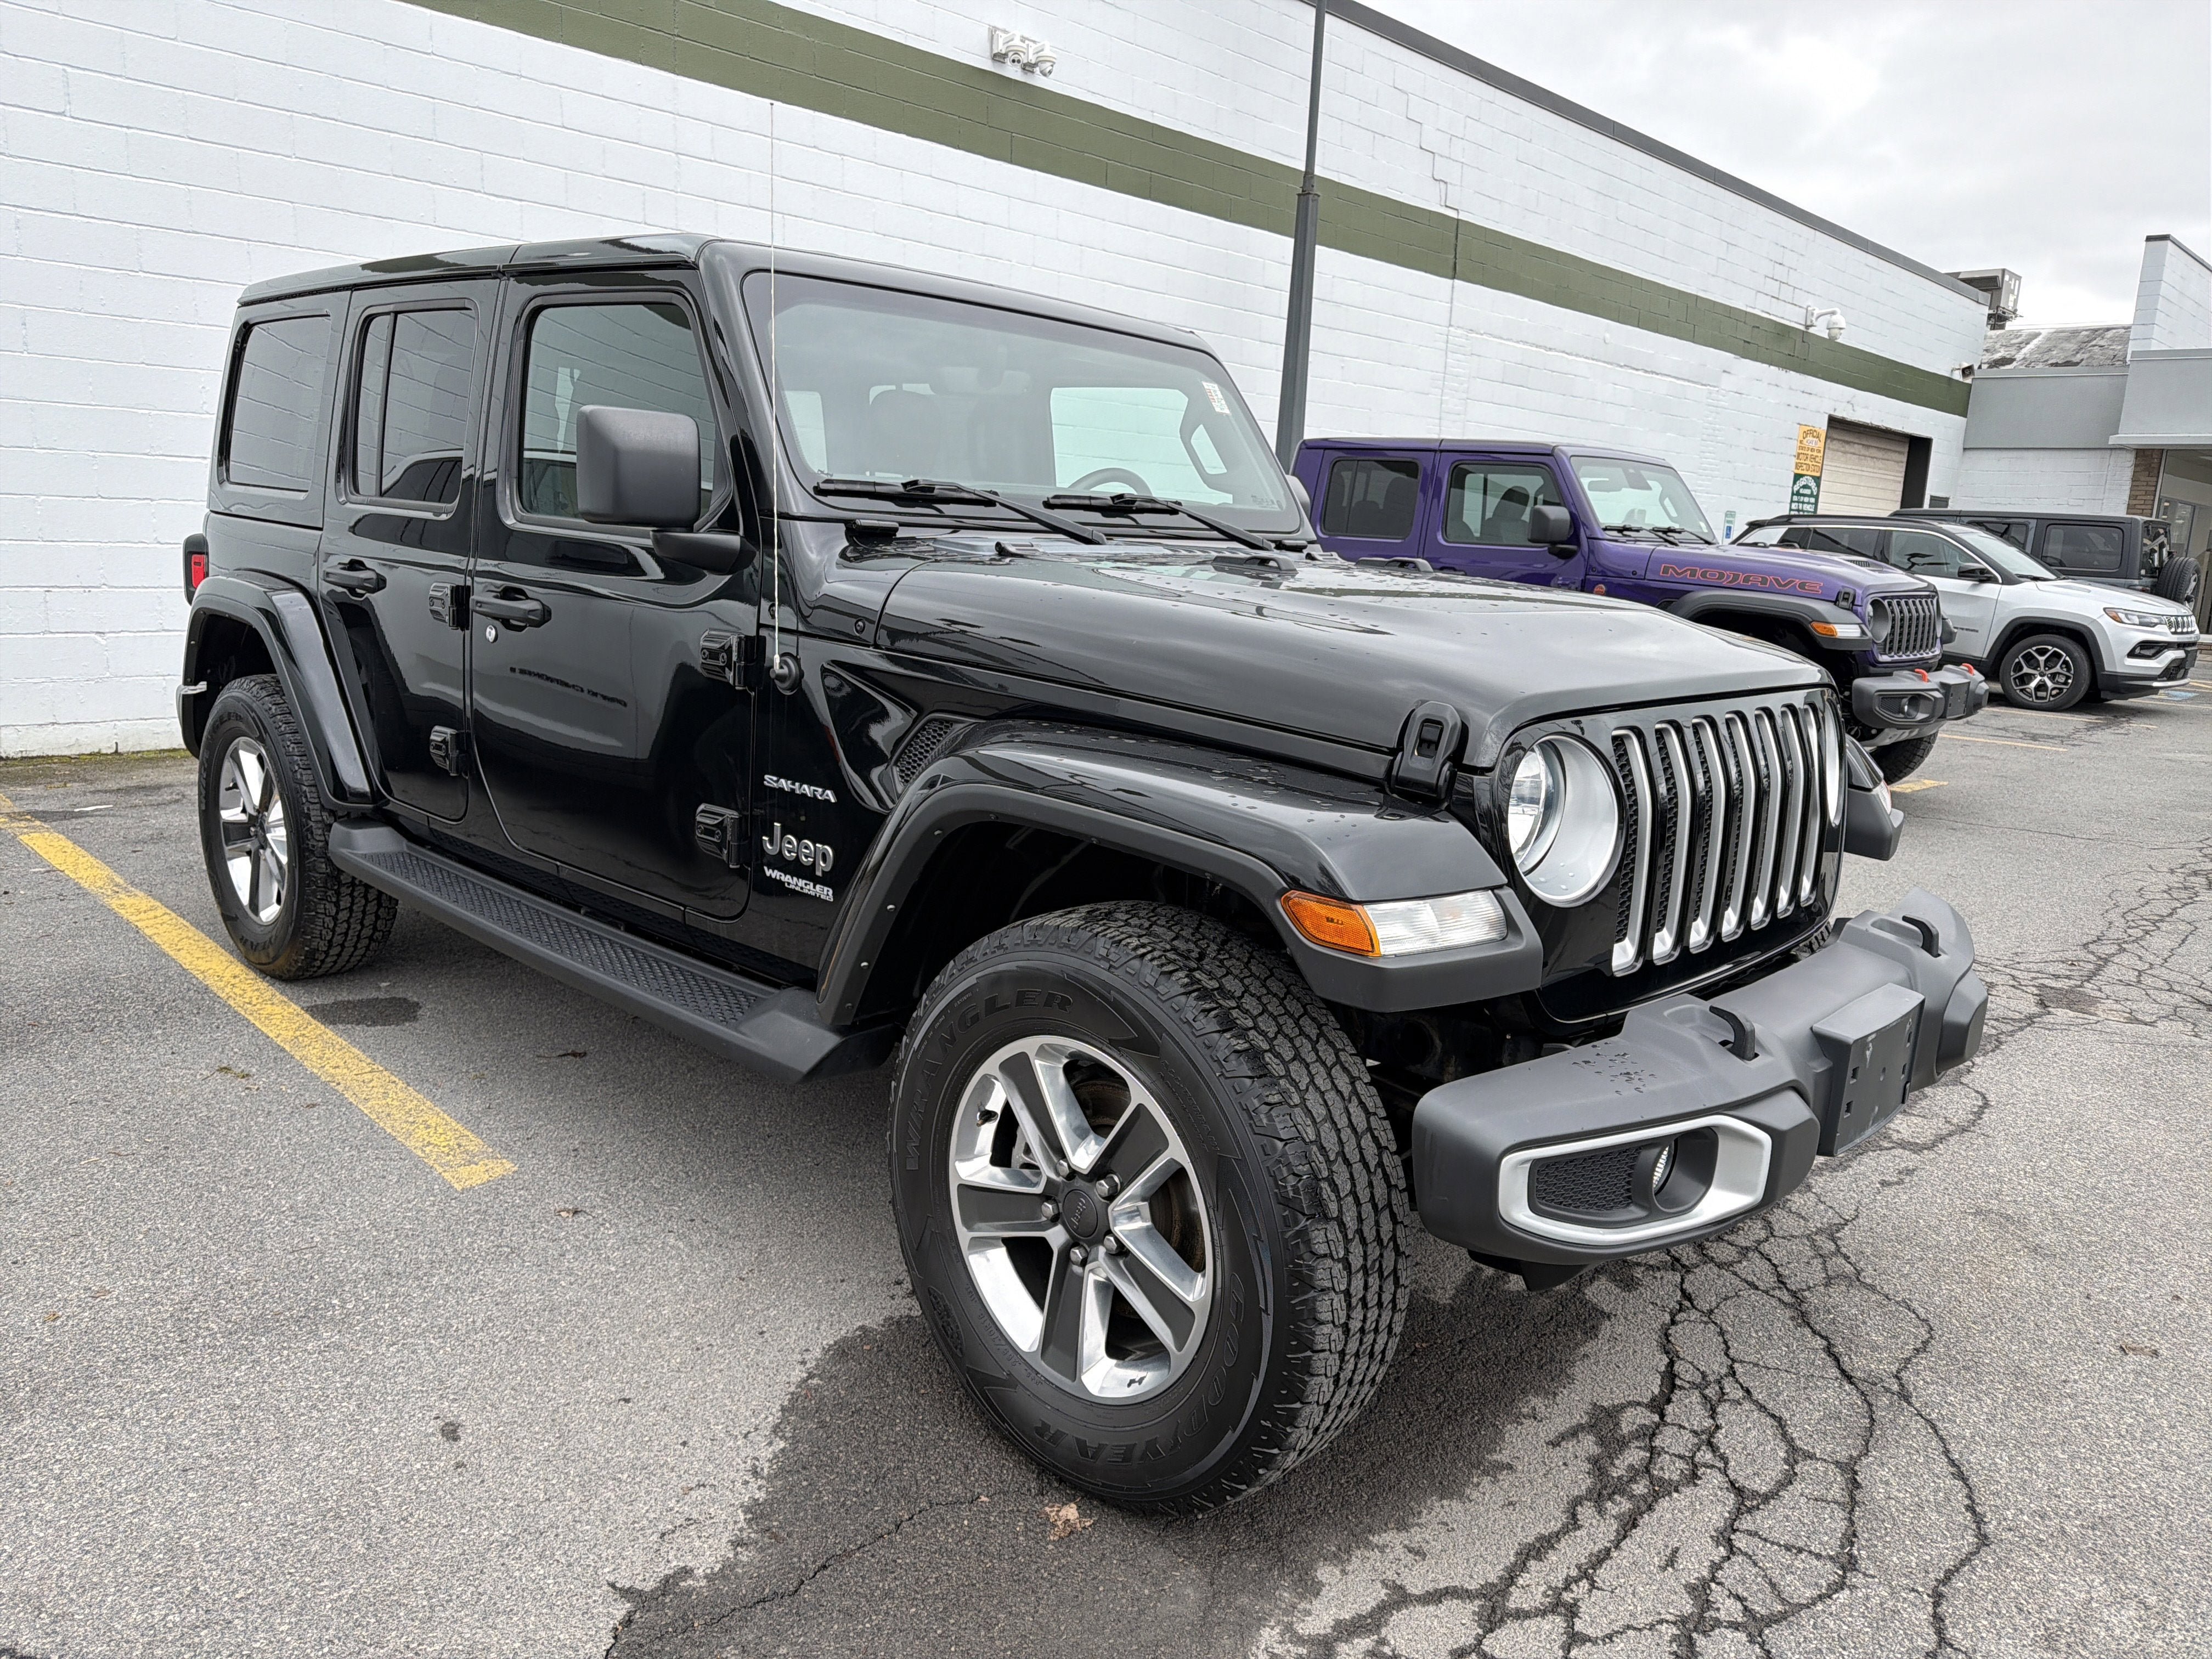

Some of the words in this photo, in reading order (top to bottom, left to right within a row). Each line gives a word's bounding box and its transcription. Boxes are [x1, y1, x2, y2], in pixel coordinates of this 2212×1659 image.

[1802, 428, 1821, 443] OFFICIAL
[1796, 452, 1809, 462] MOTOR
[1809, 454, 1822, 464] VEHICLE
[1793, 476, 1818, 495] REGISTERED
[1660, 564, 1823, 594] MOJAVE
[763, 774, 837, 803] SAHARA
[762, 822, 834, 877] Jeep
[763, 866, 833, 896] WRANGLER
[785, 881, 833, 901] UNLIMITED
[906, 988, 1074, 1171] WRANGLER
[1034, 1271, 1245, 1466] GOODYEAR
